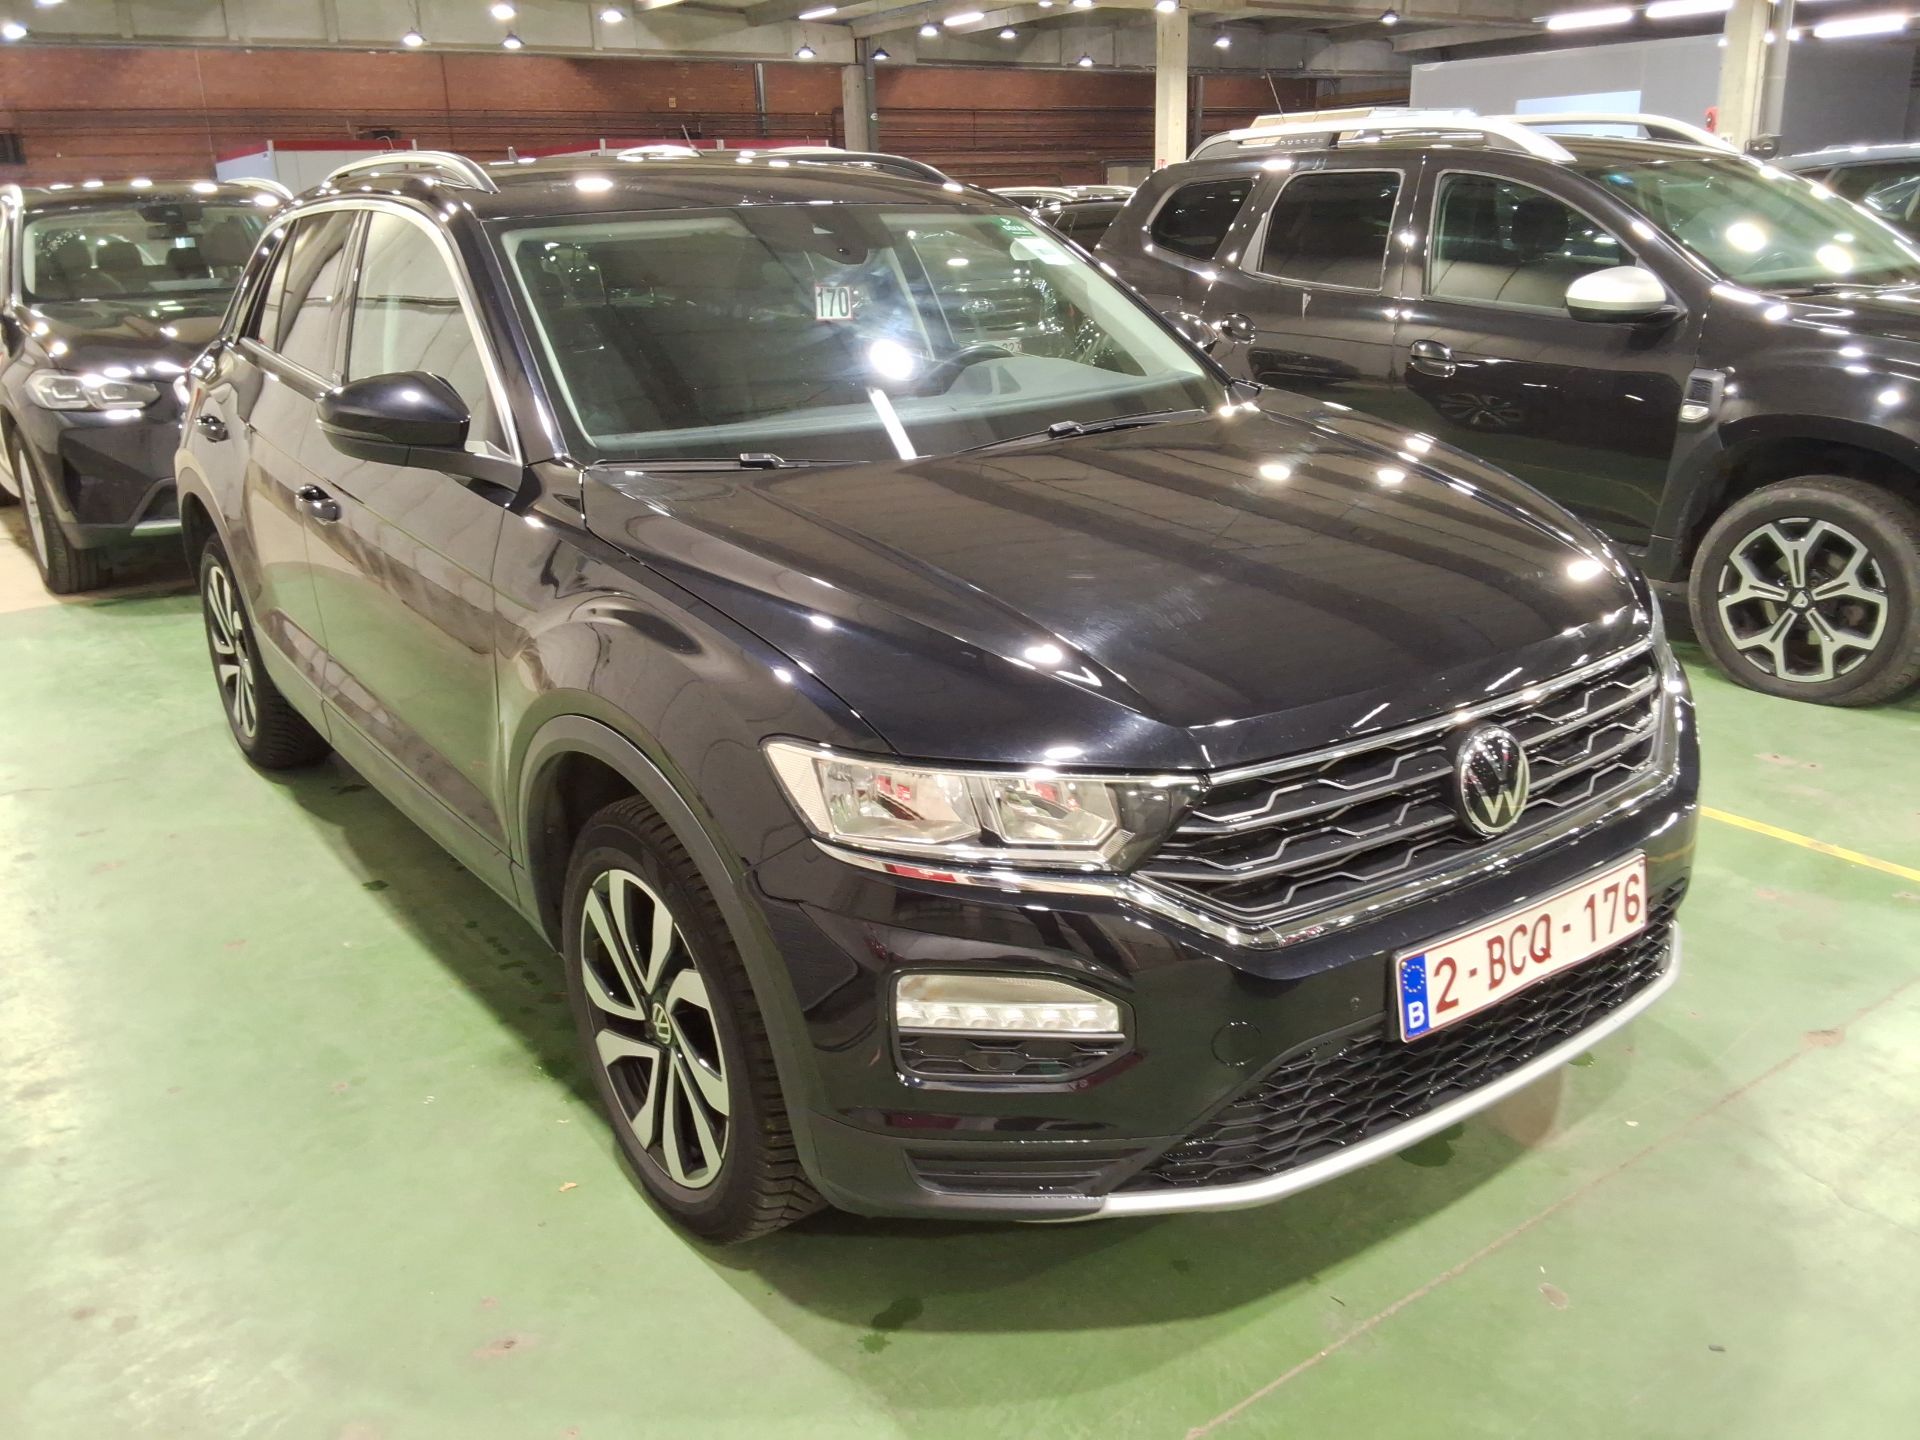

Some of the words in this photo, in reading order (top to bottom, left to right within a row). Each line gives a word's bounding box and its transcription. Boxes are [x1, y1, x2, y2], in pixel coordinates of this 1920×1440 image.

[817, 287, 850, 318] 170
[1432, 873, 1641, 1014] 2-BCQ-176
[1407, 1000, 1426, 1029] B
